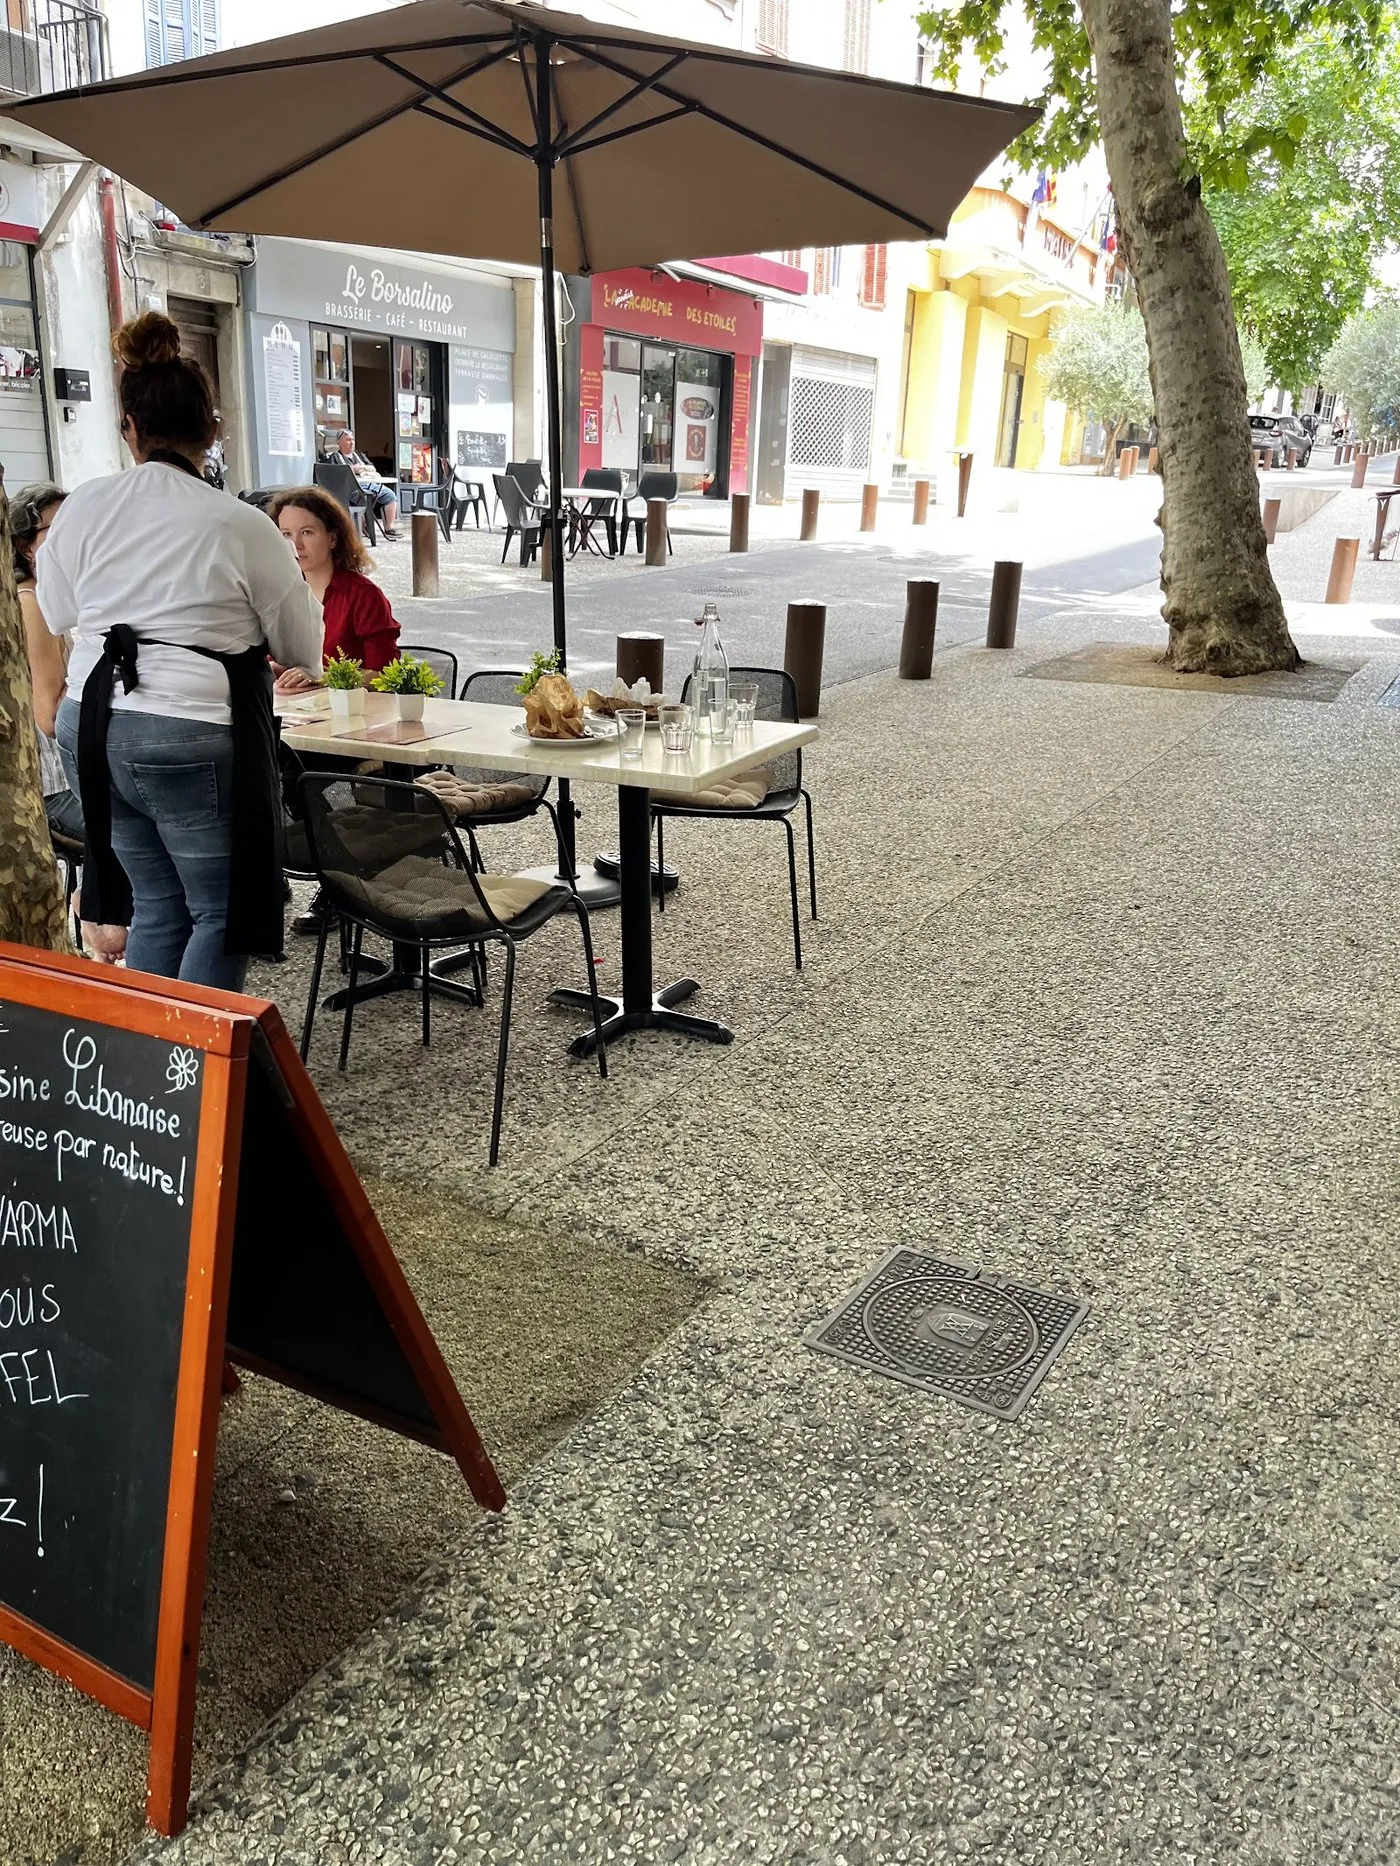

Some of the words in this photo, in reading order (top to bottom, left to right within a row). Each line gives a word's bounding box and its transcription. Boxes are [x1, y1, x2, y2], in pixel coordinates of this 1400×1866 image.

[342, 265, 367, 305] Le
[370, 269, 454, 314] Borsalino
[628, 294, 673, 317] ACADEMIE
[686, 306, 702, 324] DES
[703, 310, 736, 333] ETOILES
[325, 302, 372, 322] BRASSERIE
[386, 312, 406, 328] CAFÉ
[418, 319, 468, 339] RESTAURANT
[62, 1028, 181, 1138] Libanaise
[54, 1130, 97, 1182] par
